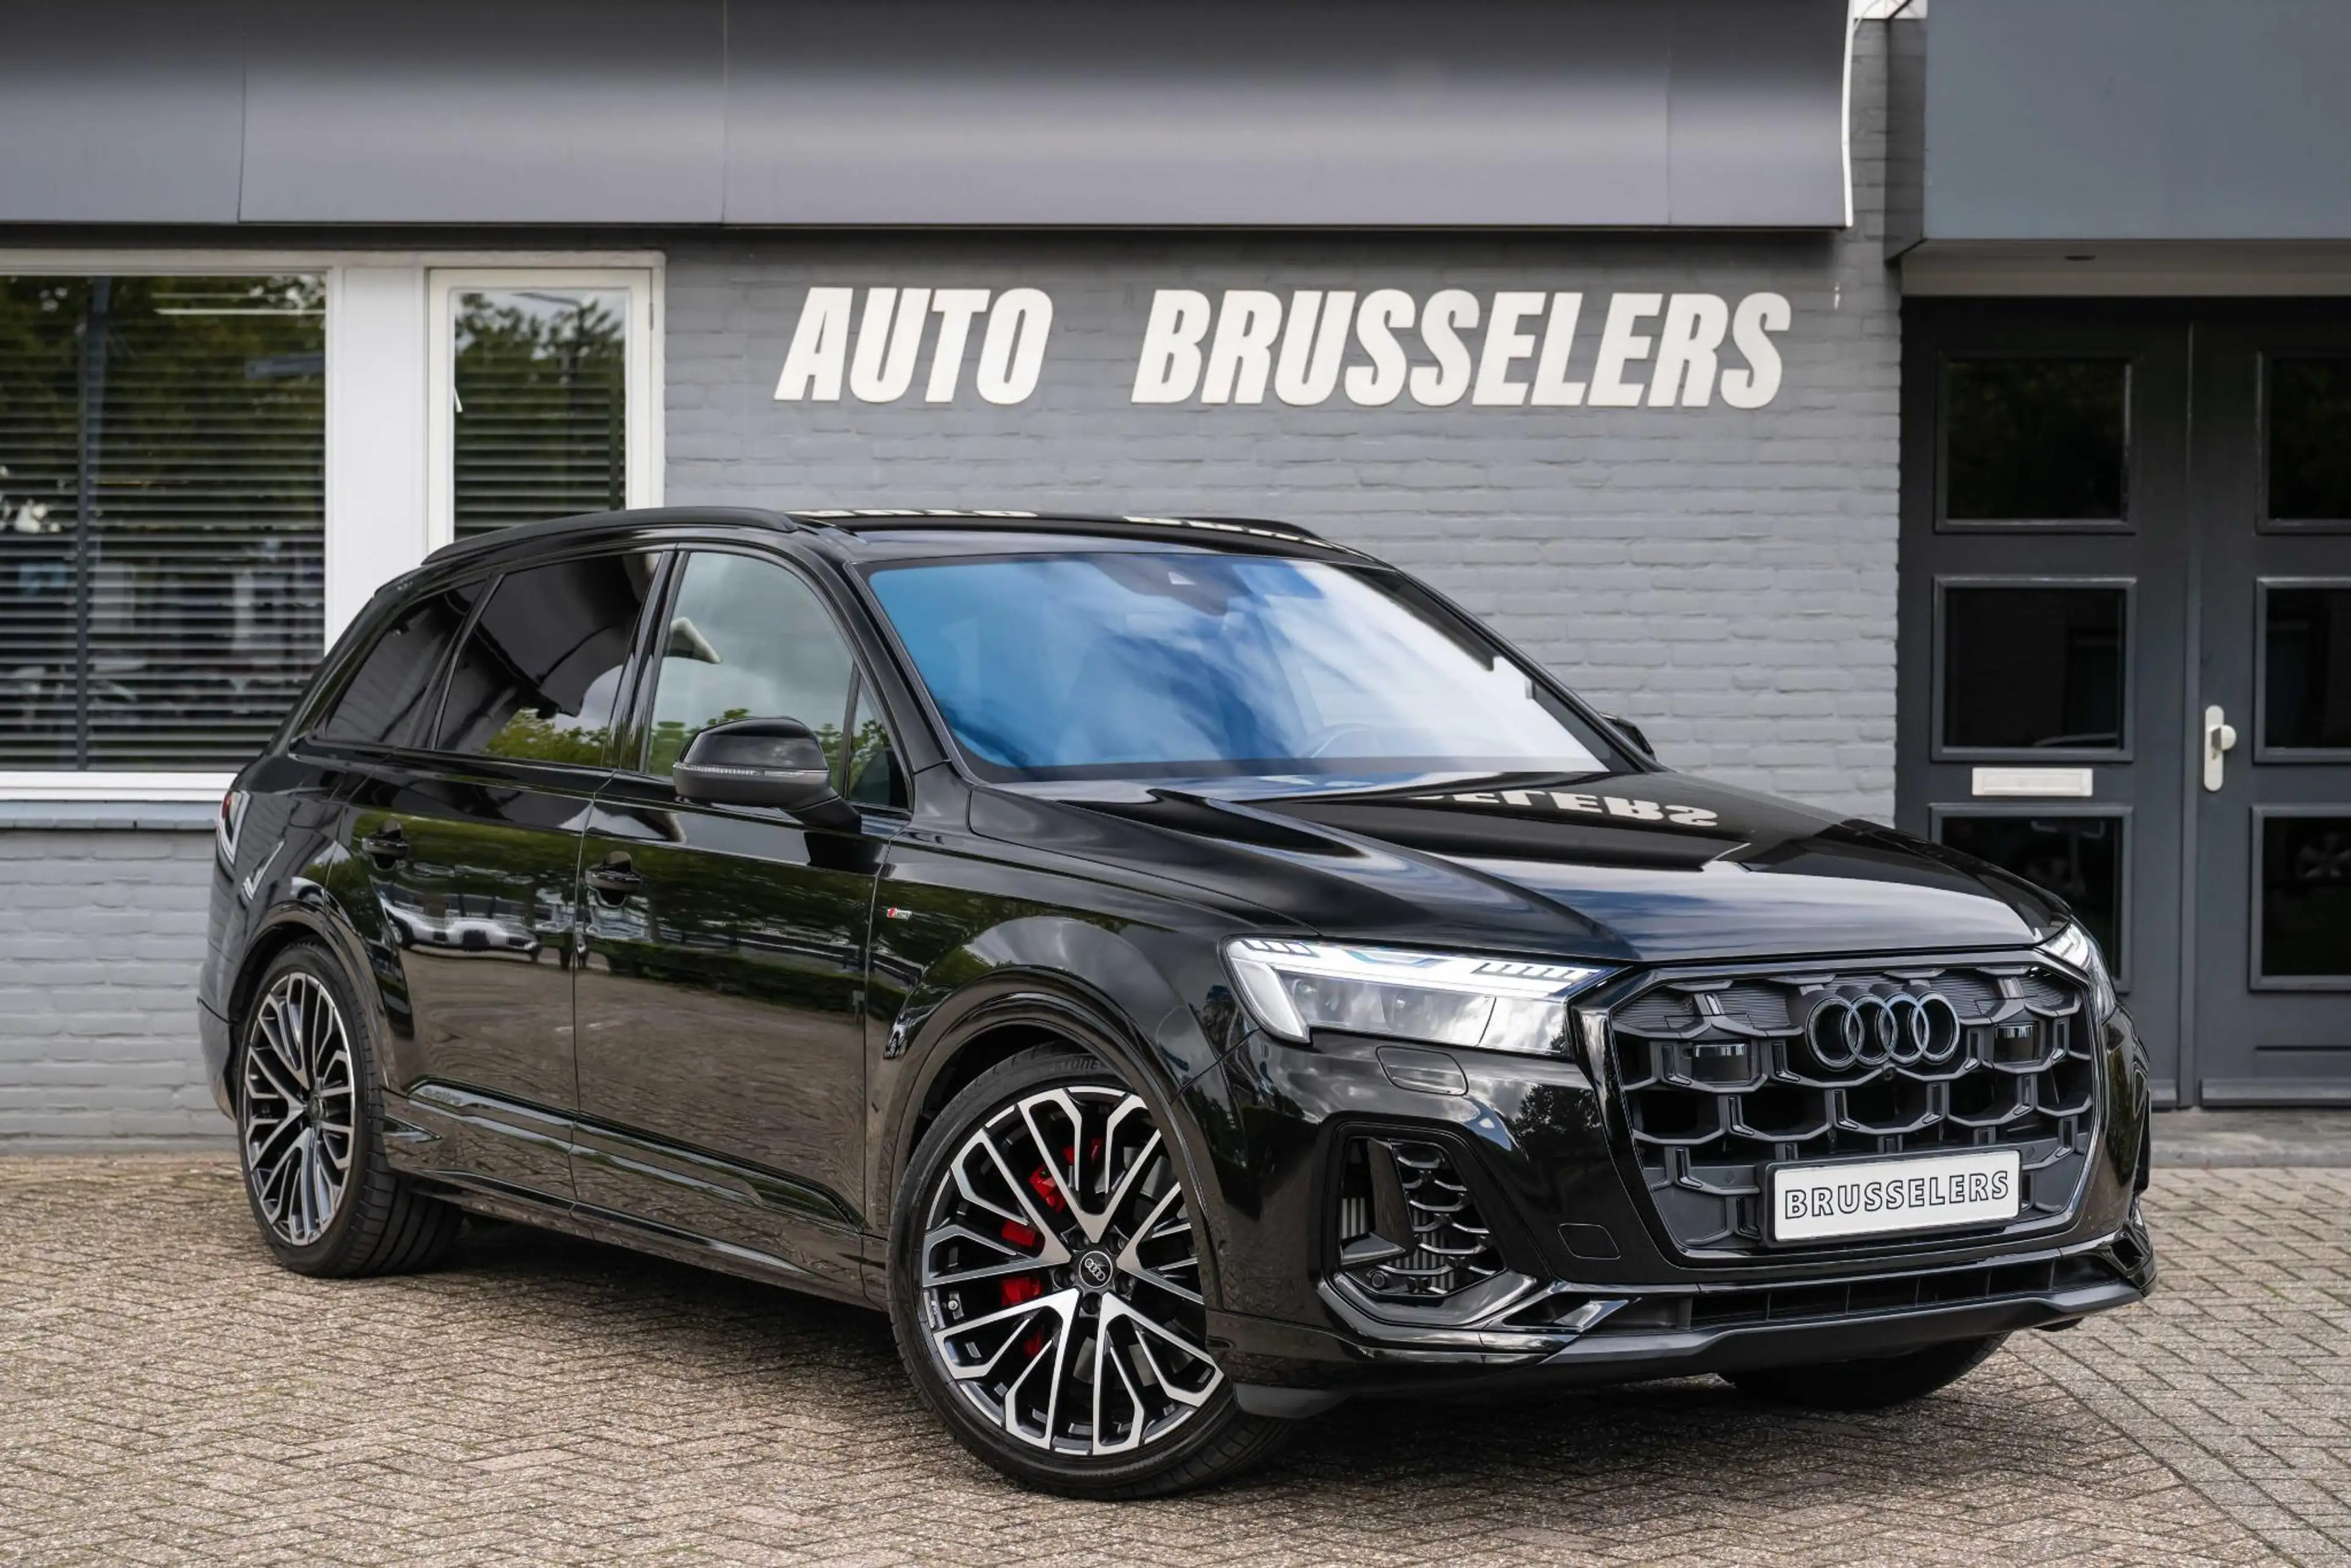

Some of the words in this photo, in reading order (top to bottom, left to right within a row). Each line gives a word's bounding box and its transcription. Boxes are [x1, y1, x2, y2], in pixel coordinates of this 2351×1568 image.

[773, 287, 1053, 405] AUTO
[1131, 289, 1790, 408] BRUSSELERS
[1785, 1170, 2009, 1220] BRUSSELERS
